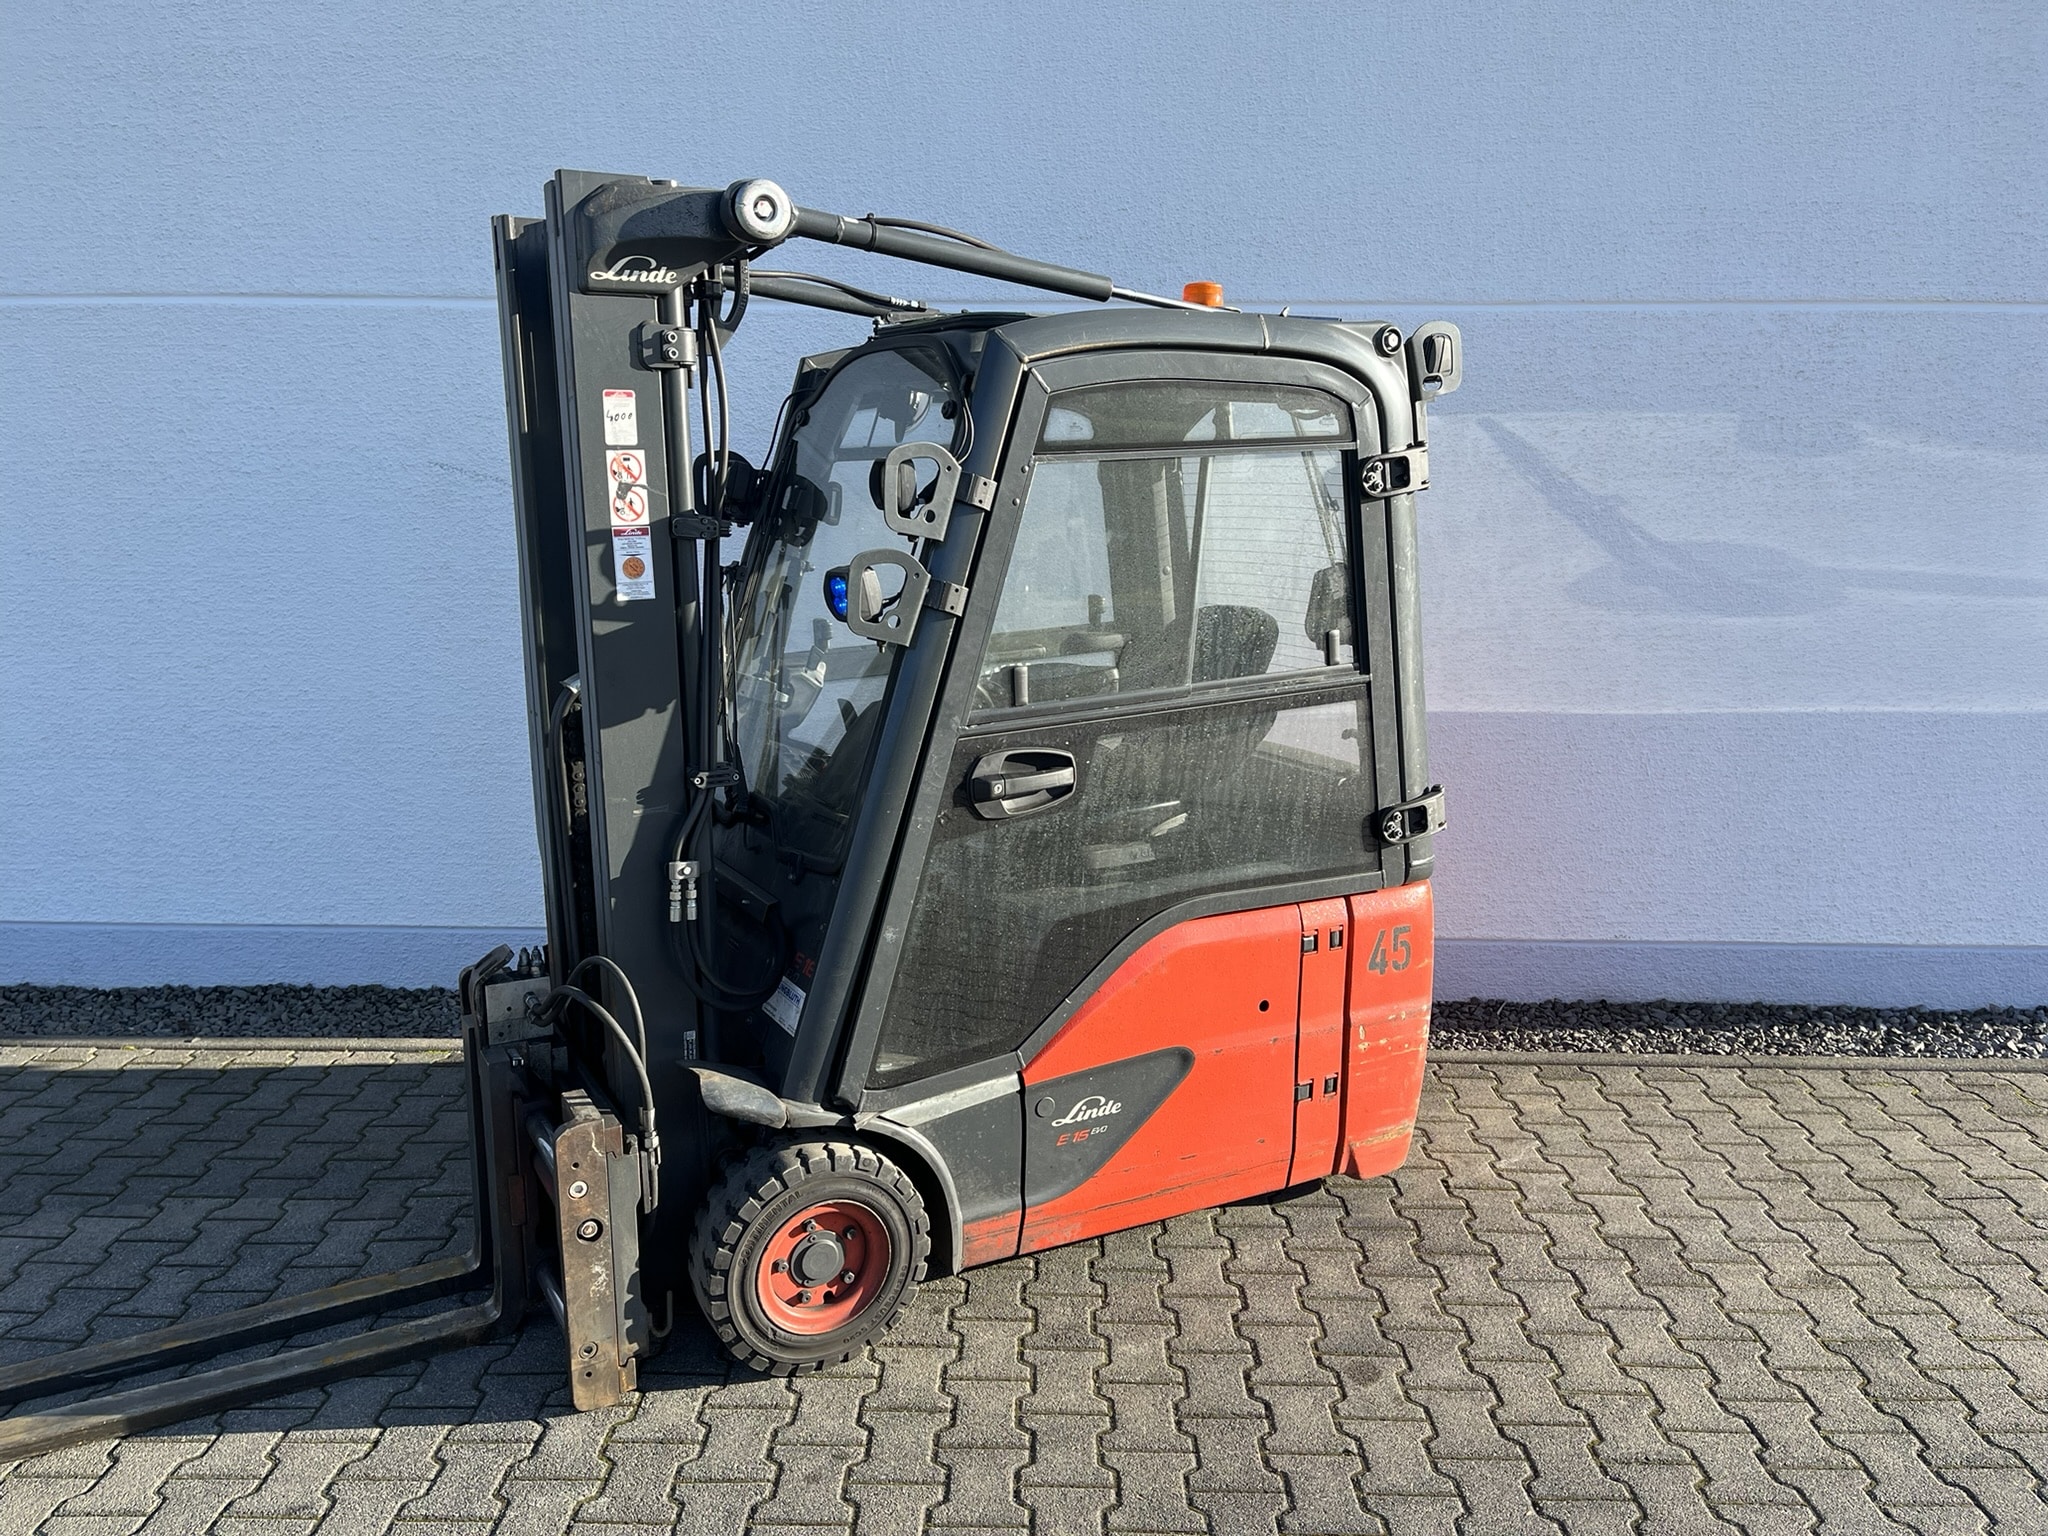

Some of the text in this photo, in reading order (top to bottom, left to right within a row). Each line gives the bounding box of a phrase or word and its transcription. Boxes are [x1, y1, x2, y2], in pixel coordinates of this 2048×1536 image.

[590, 255, 678, 284] Linde
[1368, 925, 1411, 975] 45
[1051, 1095, 1122, 1127] Linde
[1056, 1133, 1071, 1146] E
